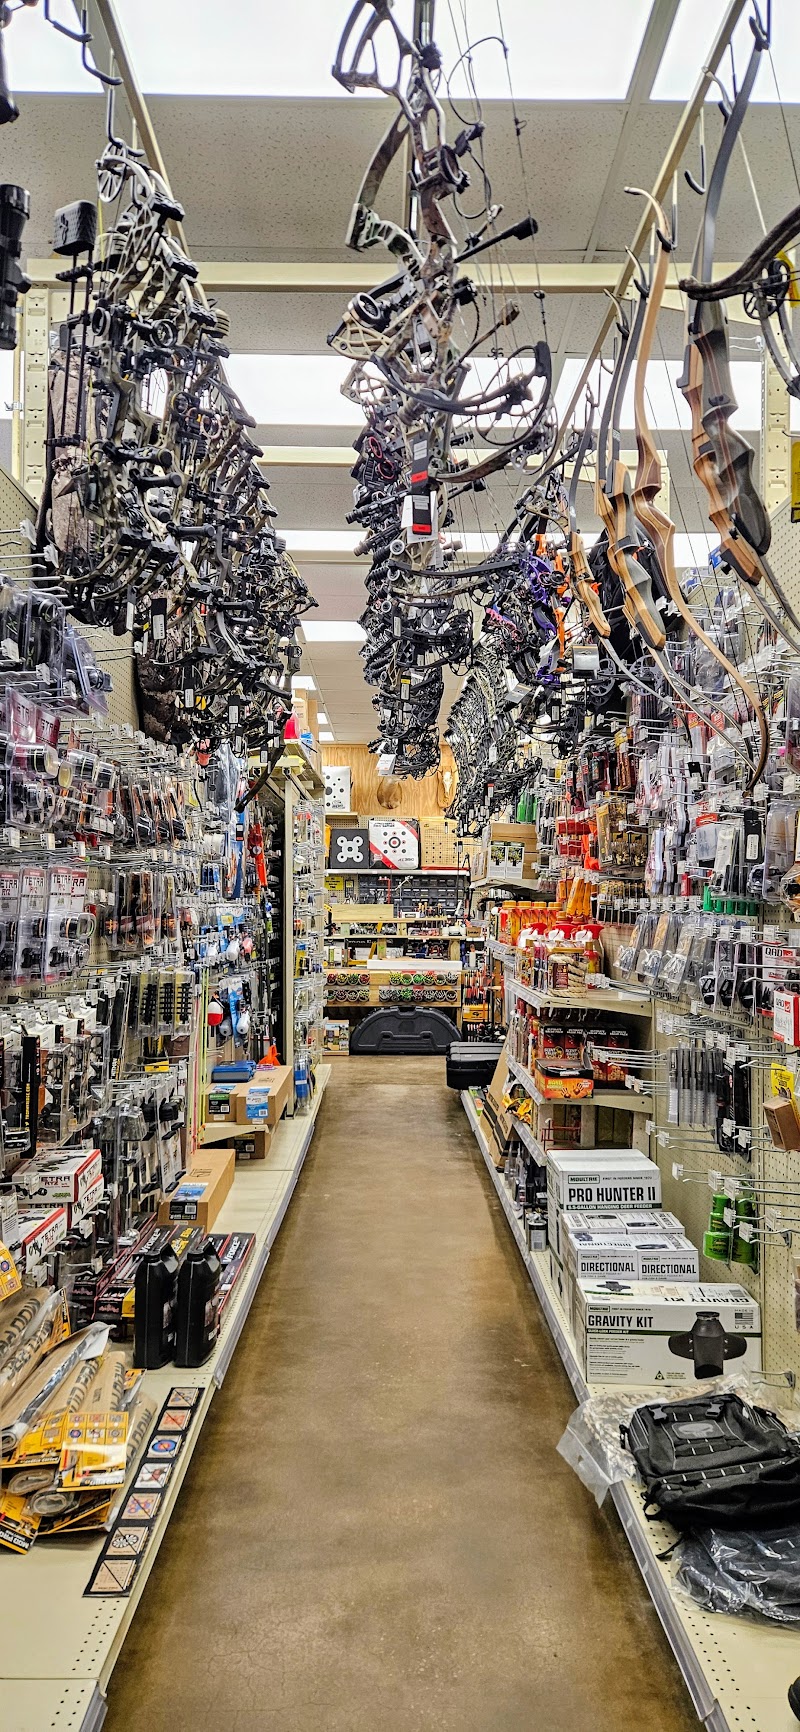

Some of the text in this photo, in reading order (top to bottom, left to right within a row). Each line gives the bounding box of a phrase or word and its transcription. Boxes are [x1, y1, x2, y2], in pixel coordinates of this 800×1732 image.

[0, 879, 18, 889] ETRA
[765, 947, 783, 957] QAD
[569, 1187, 656, 1202] PRO HUNTER II
[581, 1262, 636, 1272] DIRECTIONAL
[641, 1264, 697, 1274] DIRECTIONAL
[588, 1315, 654, 1328] GRAVITY KIT
